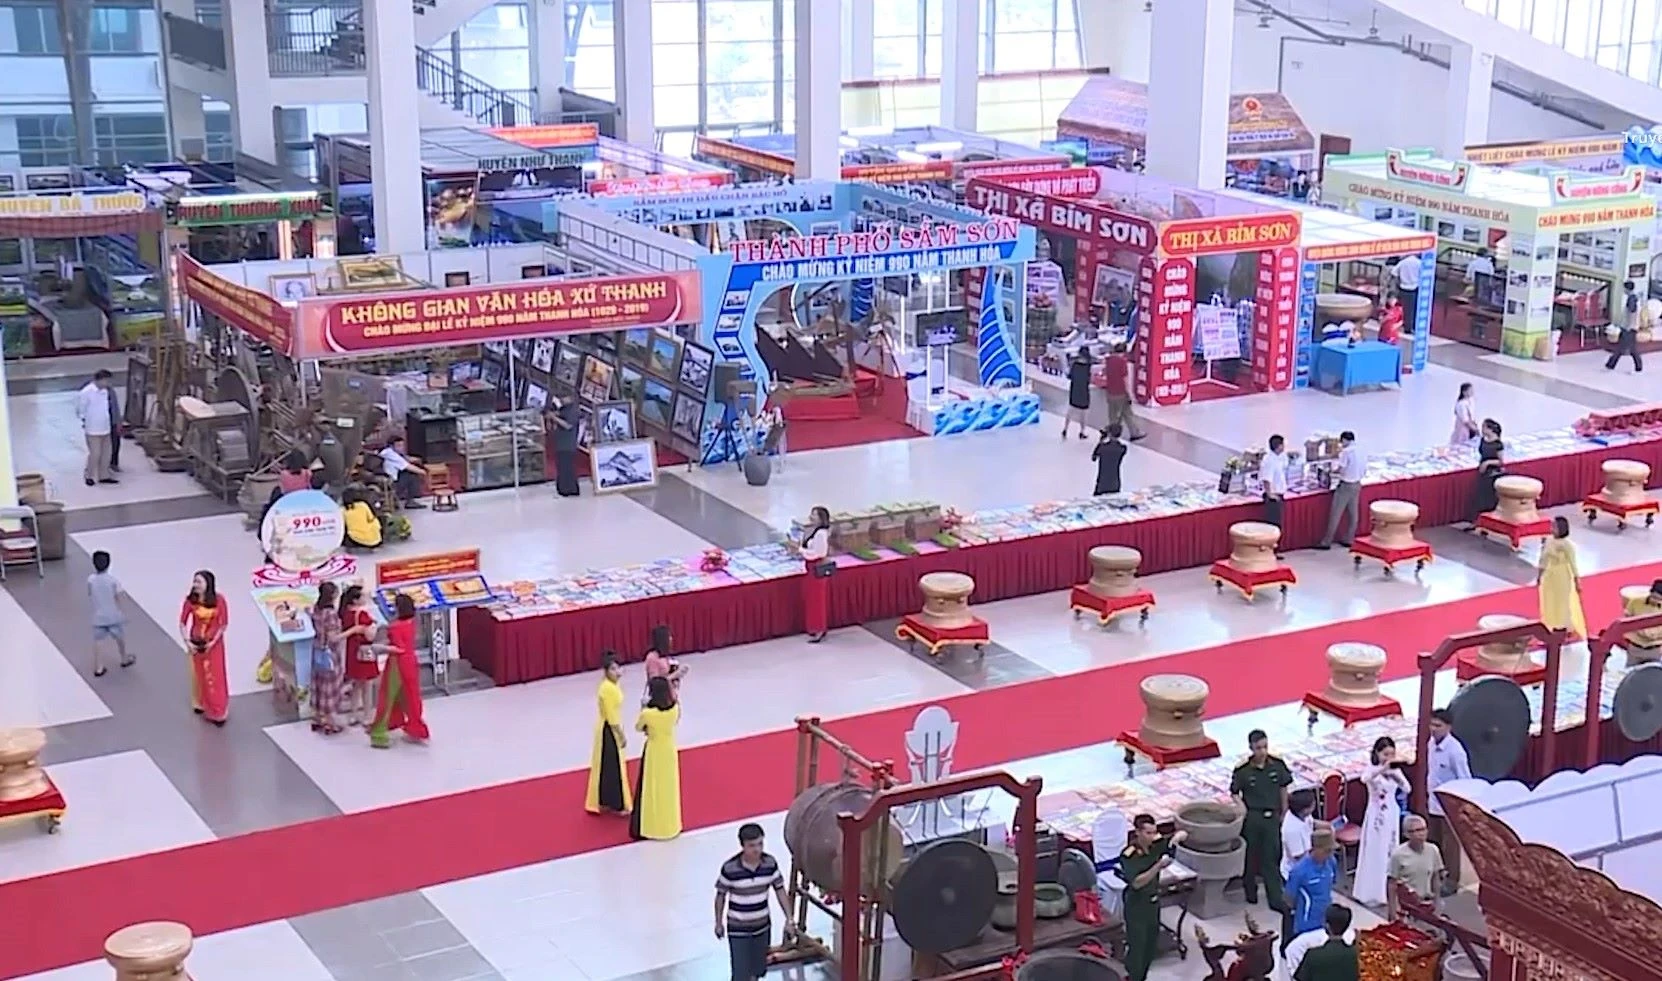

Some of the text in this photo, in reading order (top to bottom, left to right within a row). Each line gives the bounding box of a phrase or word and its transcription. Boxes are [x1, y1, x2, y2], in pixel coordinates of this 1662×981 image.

[974, 186, 1008, 215] THỊ
[1014, 197, 1045, 221] XÃ
[1099, 217, 1147, 247] SƠN
[729, 213, 1019, 263] THÀNH PHỐ SẦM SƠN
[1170, 231, 1198, 252] THỊ
[1259, 222, 1292, 241] SƠN
[762, 264, 794, 280] CHÀO
[799, 260, 834, 278] MỪNG
[855, 256, 885, 274] NIỆM
[888, 255, 910, 270] 990
[913, 251, 940, 268] NĂM
[942, 247, 978, 266] THANH
[980, 245, 1000, 263] HÓA
[341, 281, 667, 325] KHÔNG GIAN VĂN HÓA XỨ THANH
[363, 324, 391, 338] CHÀO
[539, 309, 570, 321] THANH
[293, 516, 321, 529] 990
